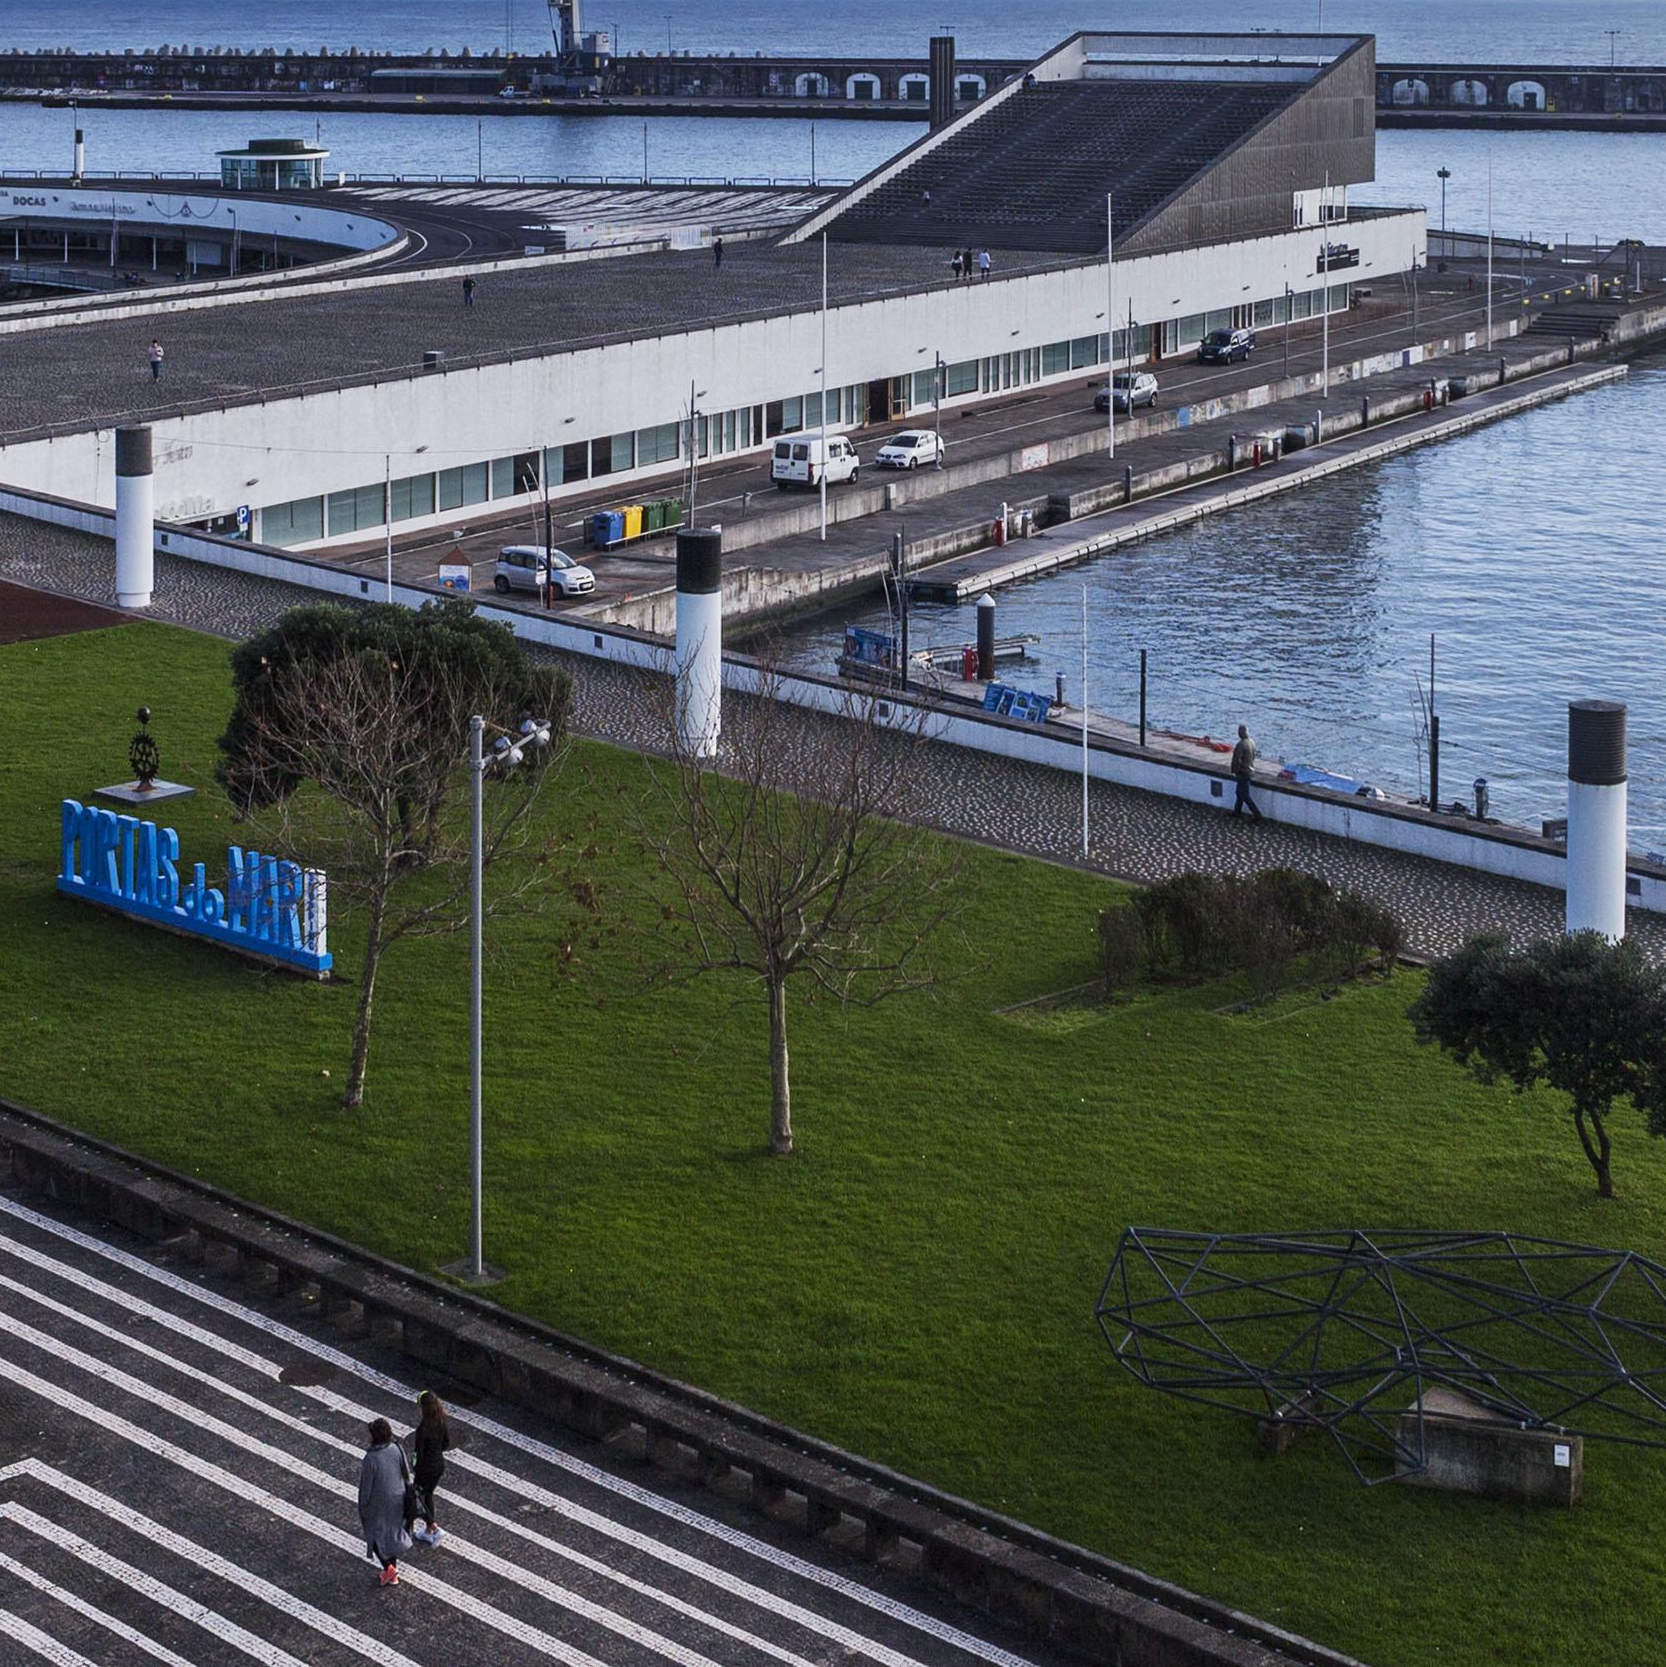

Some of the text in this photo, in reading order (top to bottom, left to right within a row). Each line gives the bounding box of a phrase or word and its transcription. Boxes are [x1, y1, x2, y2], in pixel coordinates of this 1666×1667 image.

[13, 196, 47, 207] DOCAS
[62, 799, 180, 909] PORTAS
[185, 863, 225, 923] do
[228, 845, 303, 950] MAR
